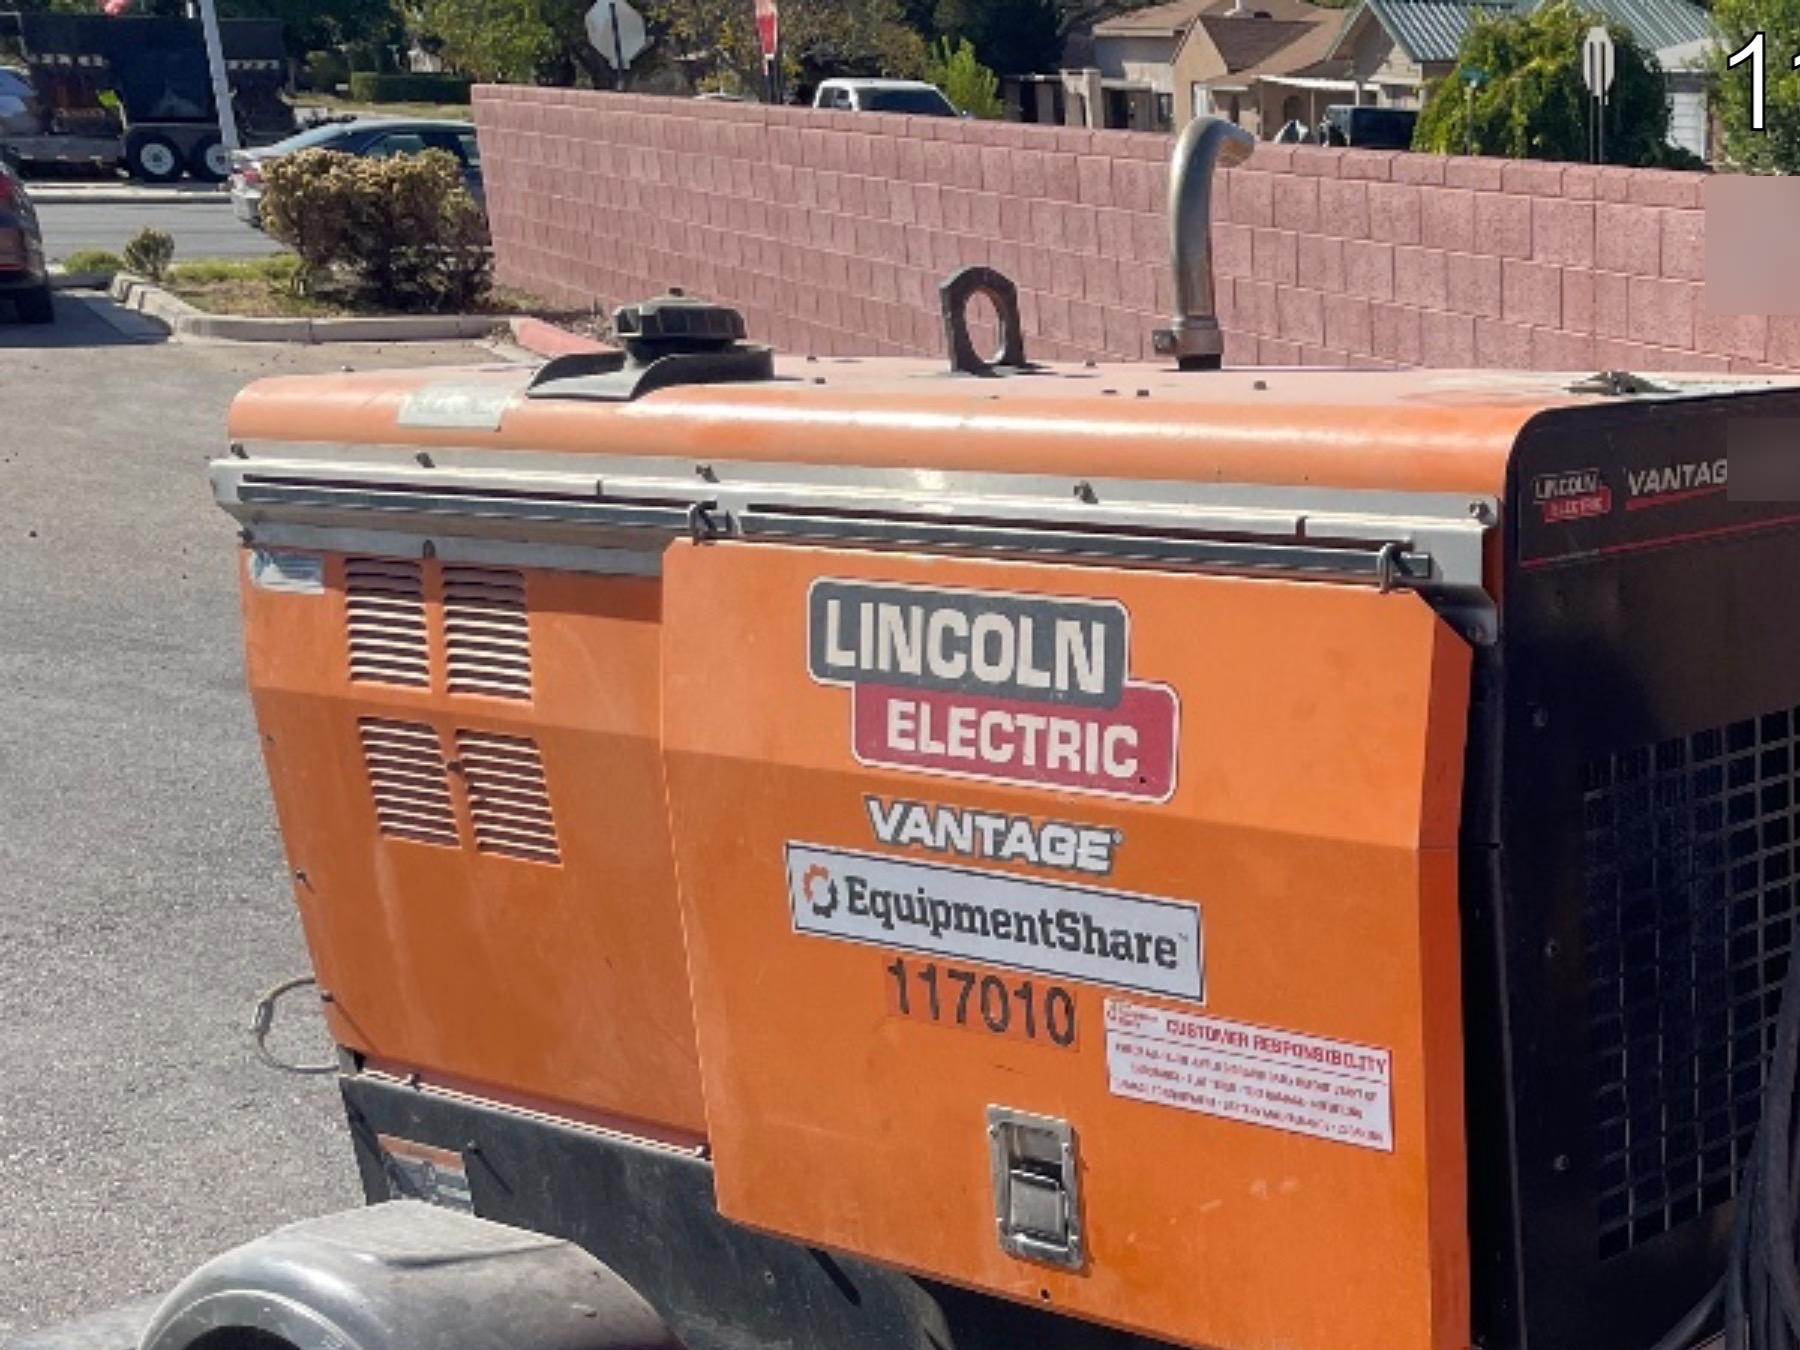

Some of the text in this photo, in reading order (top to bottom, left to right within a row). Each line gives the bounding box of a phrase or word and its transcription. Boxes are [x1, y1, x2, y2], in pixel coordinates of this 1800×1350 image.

[1627, 459, 1728, 496] VANTAG
[825, 598, 1106, 694] LINCOLN
[886, 698, 1138, 778] ELECTRIC
[866, 797, 1115, 873] VANTAGE
[845, 876, 1178, 970] EquipmentShare
[888, 957, 1076, 1048] 117010
